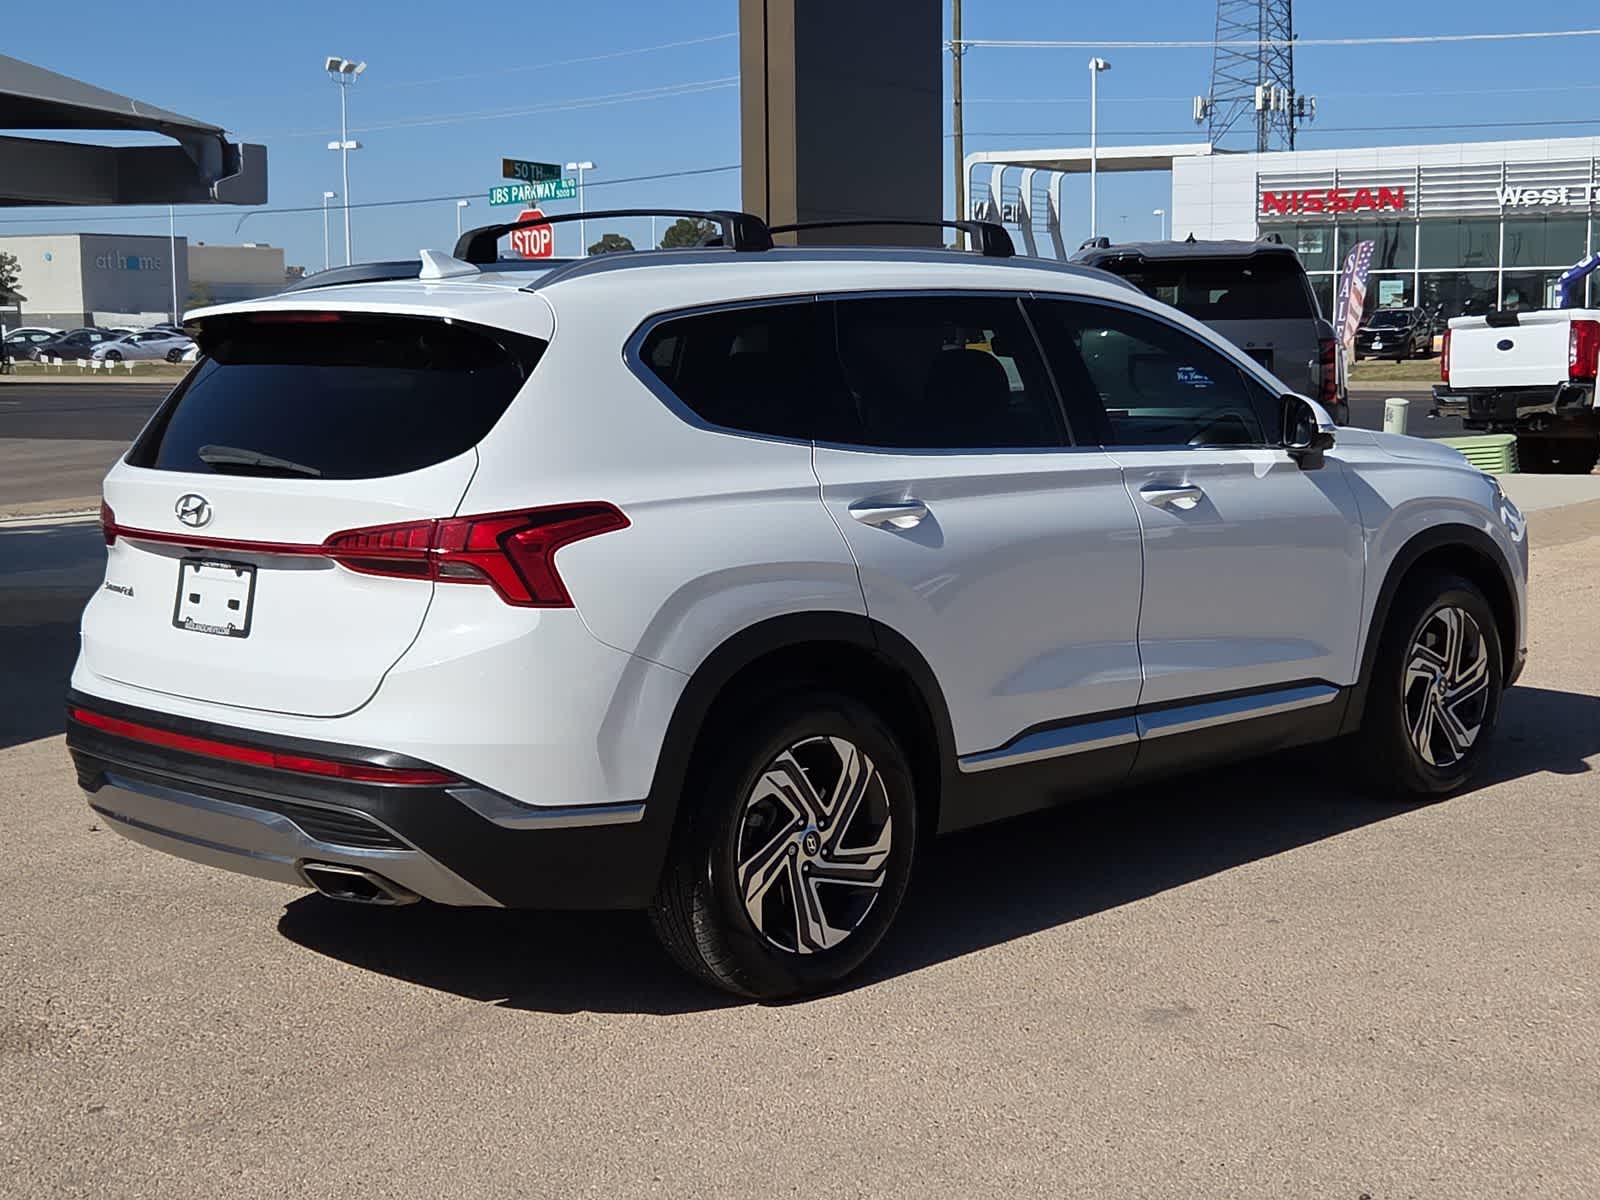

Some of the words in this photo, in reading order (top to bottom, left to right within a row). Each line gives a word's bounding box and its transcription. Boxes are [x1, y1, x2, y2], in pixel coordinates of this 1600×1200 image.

[490, 187, 509, 204] JBS
[511, 182, 556, 201] PARKWAY
[1263, 186, 1405, 213] NISSAN
[1496, 184, 1569, 207] West
[514, 229, 551, 255] STOP
